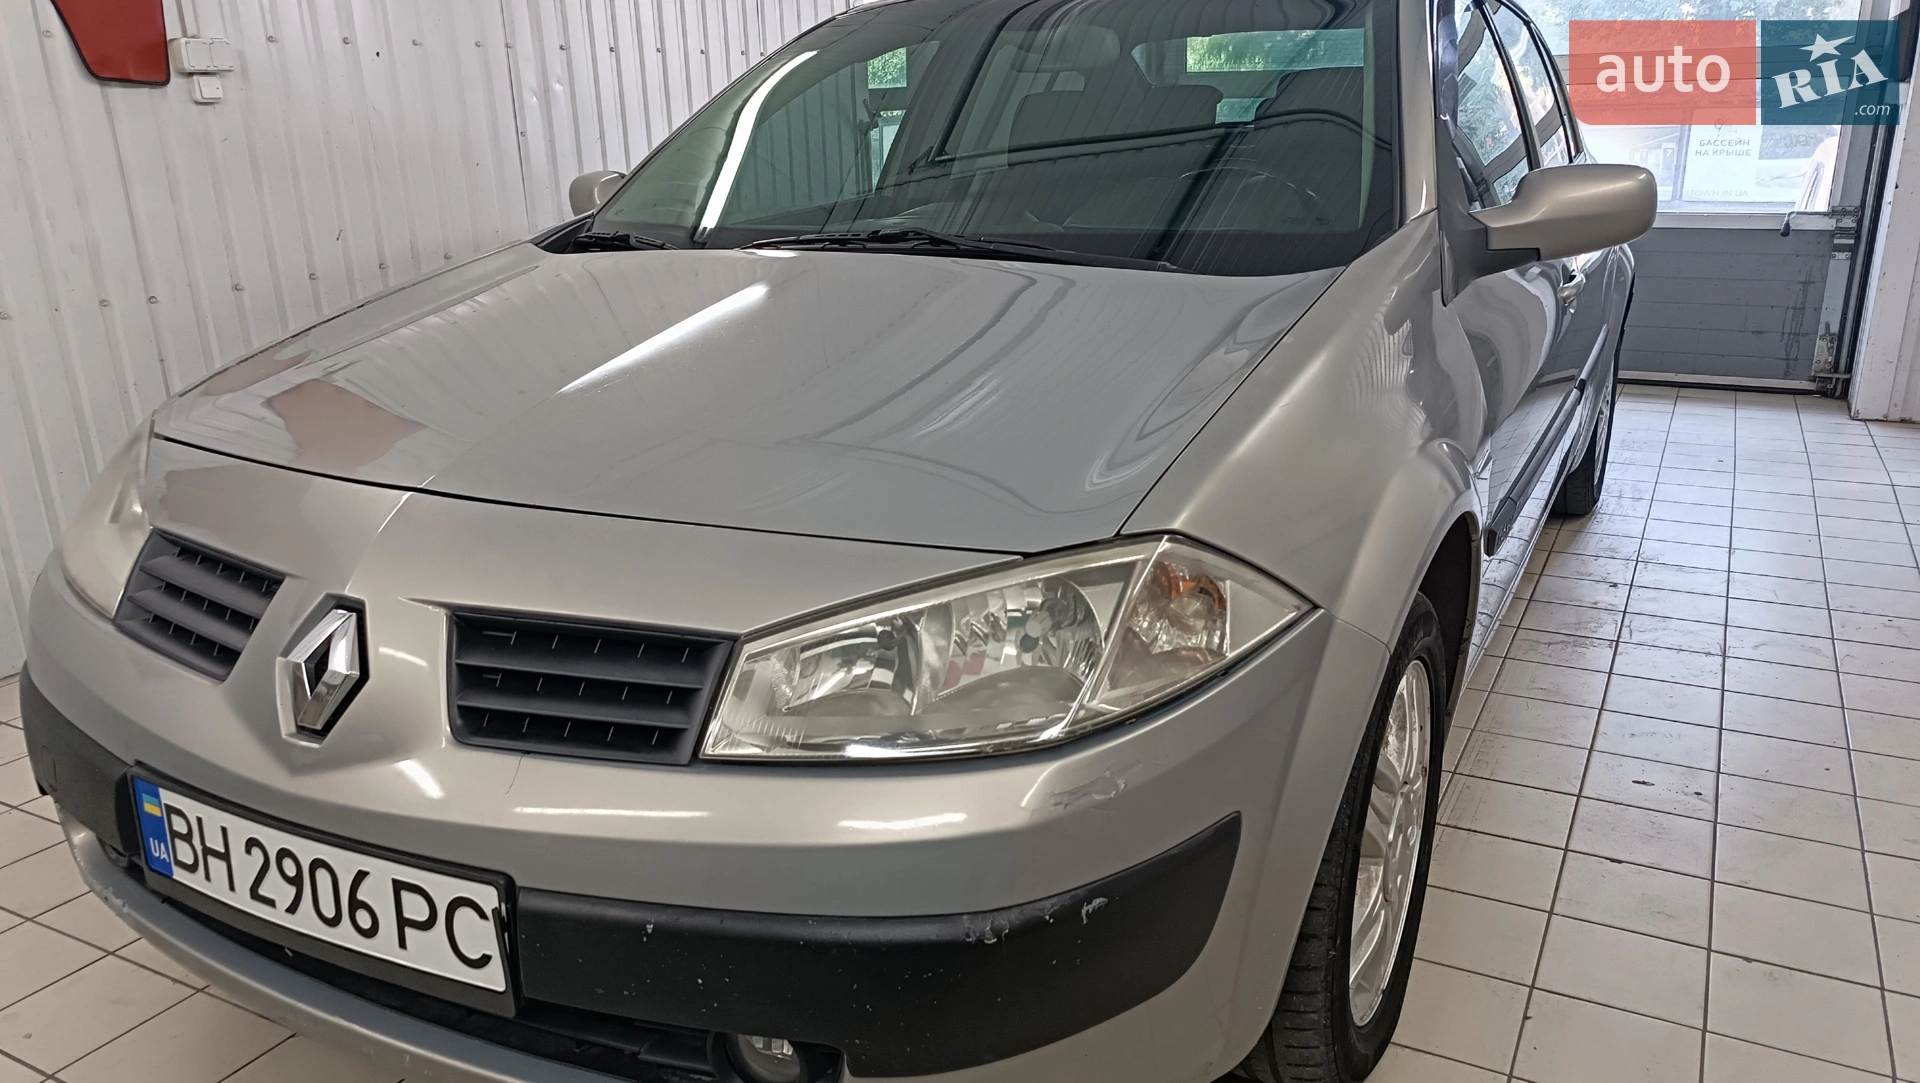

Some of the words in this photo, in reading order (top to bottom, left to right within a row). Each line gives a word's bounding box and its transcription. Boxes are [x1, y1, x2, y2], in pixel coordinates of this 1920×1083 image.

[1699, 137, 1750, 147] БАССЕЙН
[1694, 149, 1711, 157] НА
[1712, 148, 1752, 157] КРЫШЕ
[149, 837, 170, 863] UA
[163, 802, 236, 894] BH
[244, 836, 380, 940] 2906
[391, 877, 493, 970] PC
